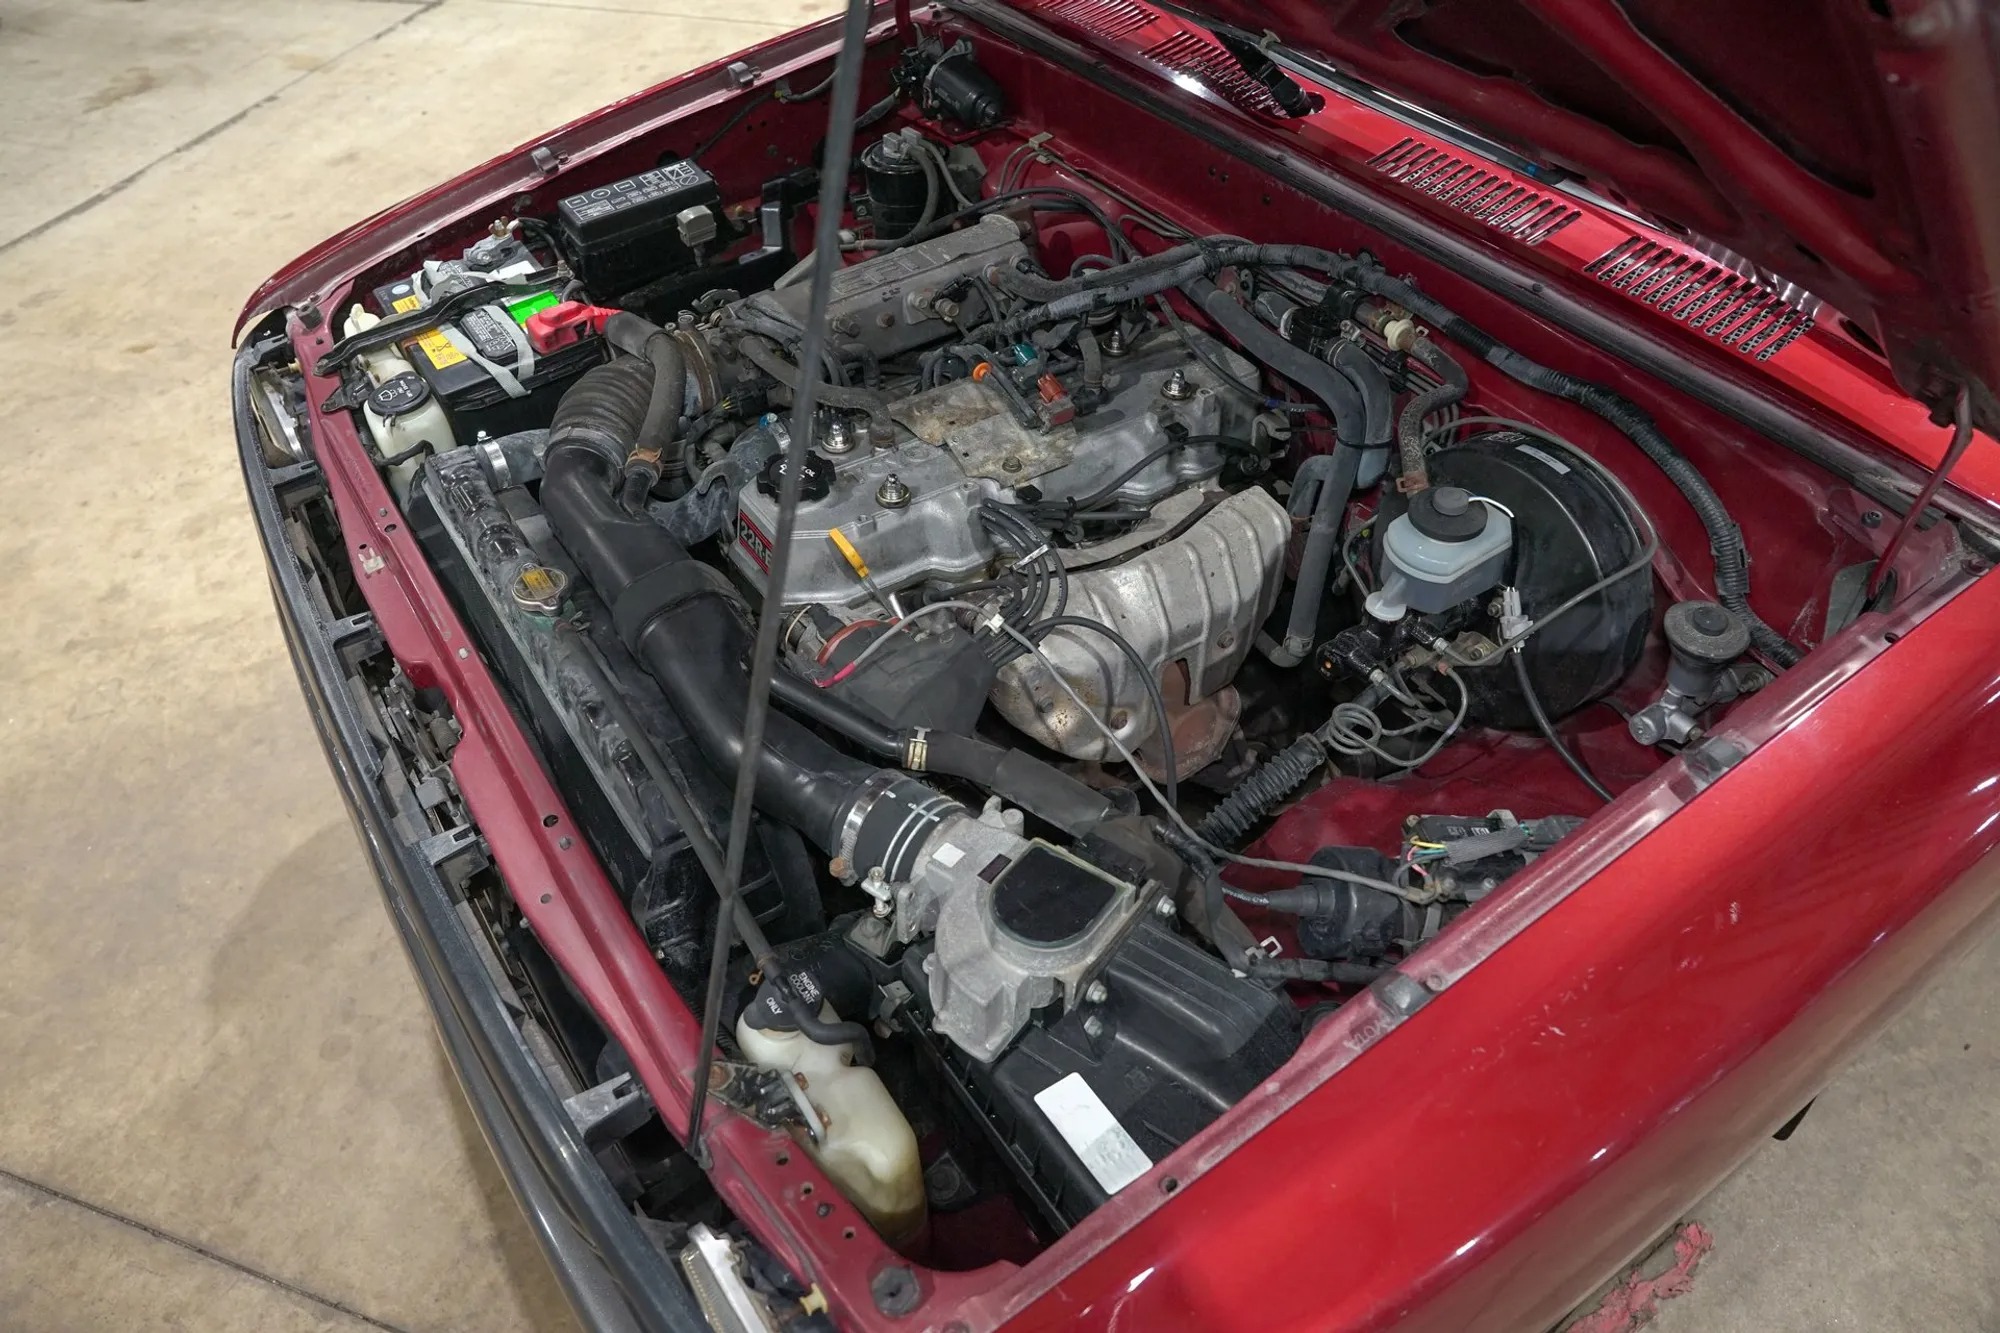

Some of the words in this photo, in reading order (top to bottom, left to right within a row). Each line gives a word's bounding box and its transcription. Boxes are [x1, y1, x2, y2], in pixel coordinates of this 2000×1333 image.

[789, 973, 815, 1004] COOLANT
[798, 971, 820, 998] ENGINE
[766, 996, 783, 1015] ONLY
